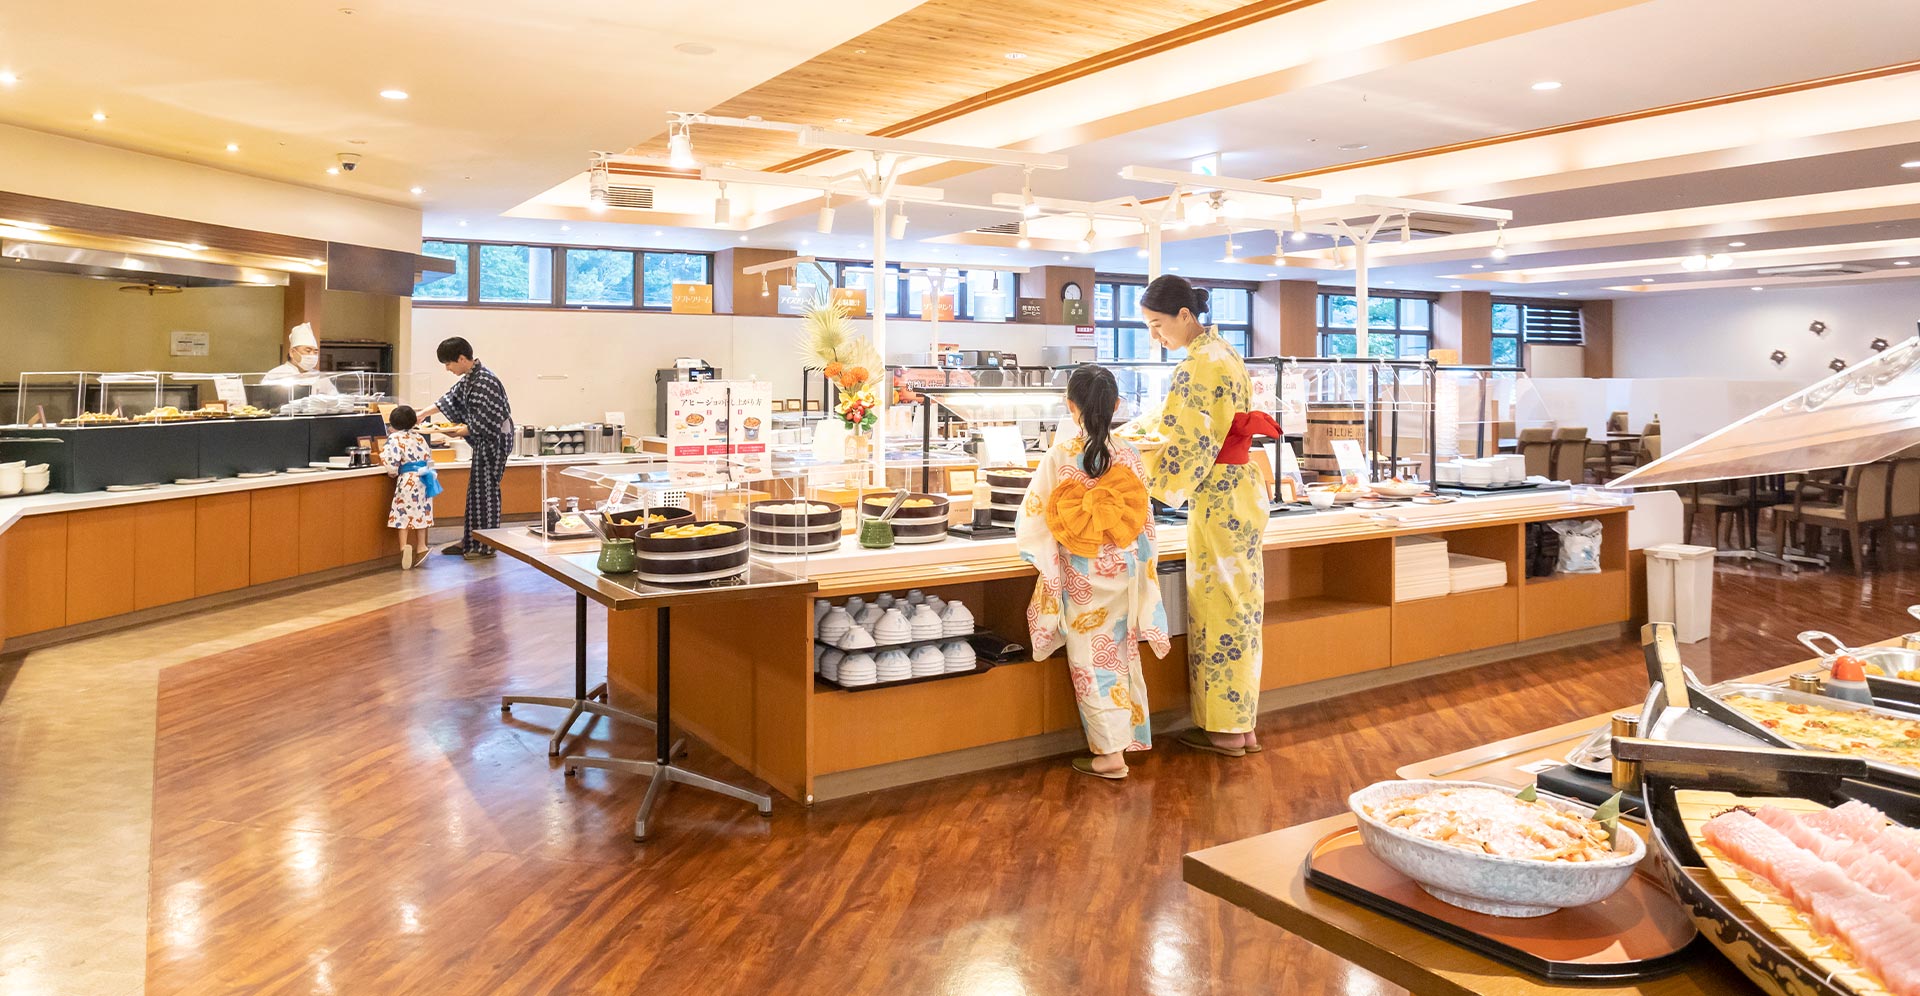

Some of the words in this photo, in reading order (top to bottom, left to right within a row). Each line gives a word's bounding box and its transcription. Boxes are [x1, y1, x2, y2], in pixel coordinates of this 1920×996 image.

[674, 295, 711, 304] ソフトクリーム
[1326, 427, 1353, 437] BLUE
